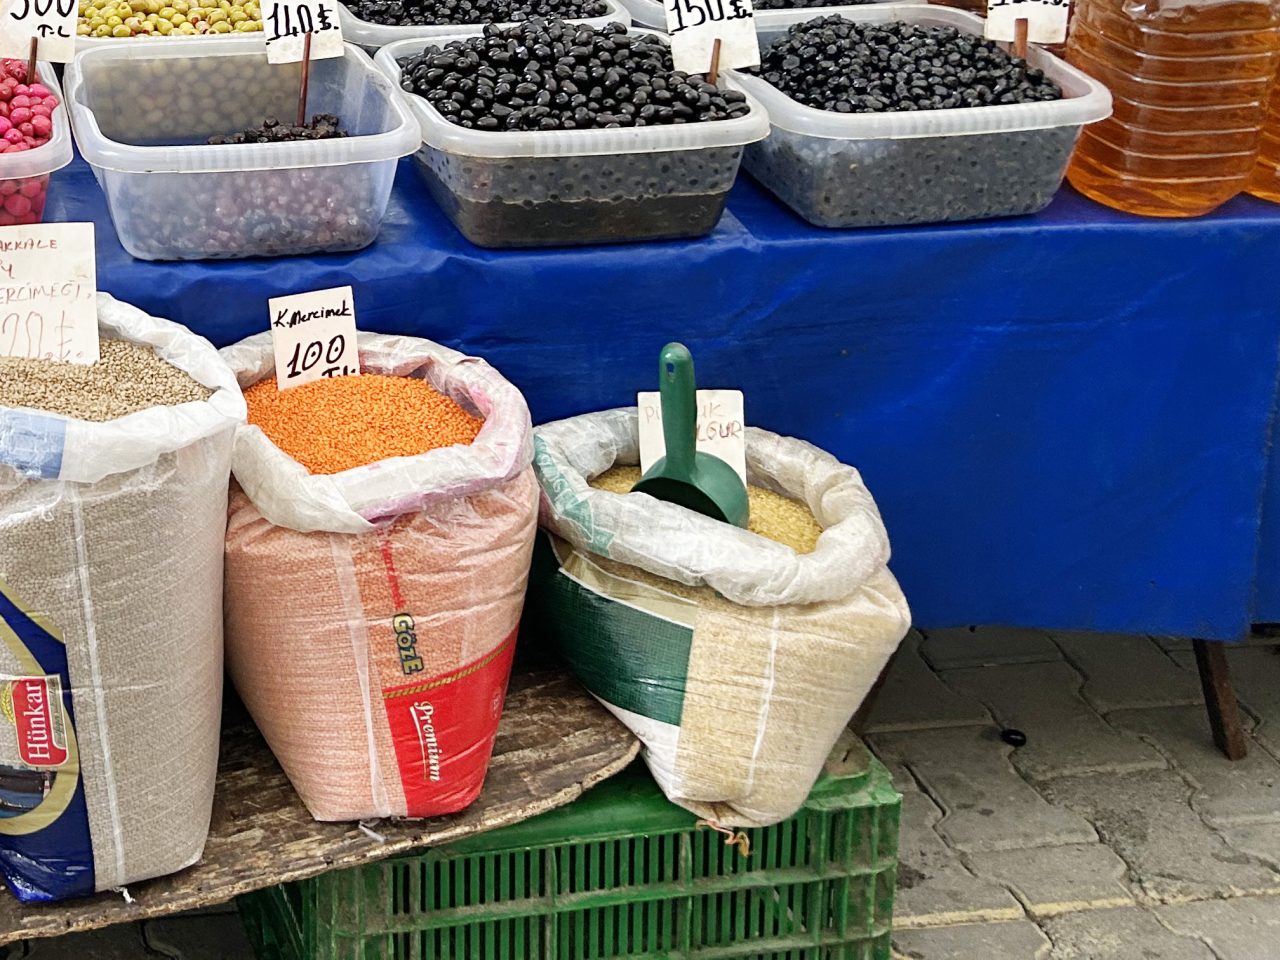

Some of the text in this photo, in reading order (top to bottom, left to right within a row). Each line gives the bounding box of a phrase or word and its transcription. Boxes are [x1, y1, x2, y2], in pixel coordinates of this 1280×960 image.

[287, 334, 345, 378] 100
[392, 612, 424, 675] GÖZE
[23, 682, 50, 759] Hünkar
[414, 700, 441, 782] Premium
